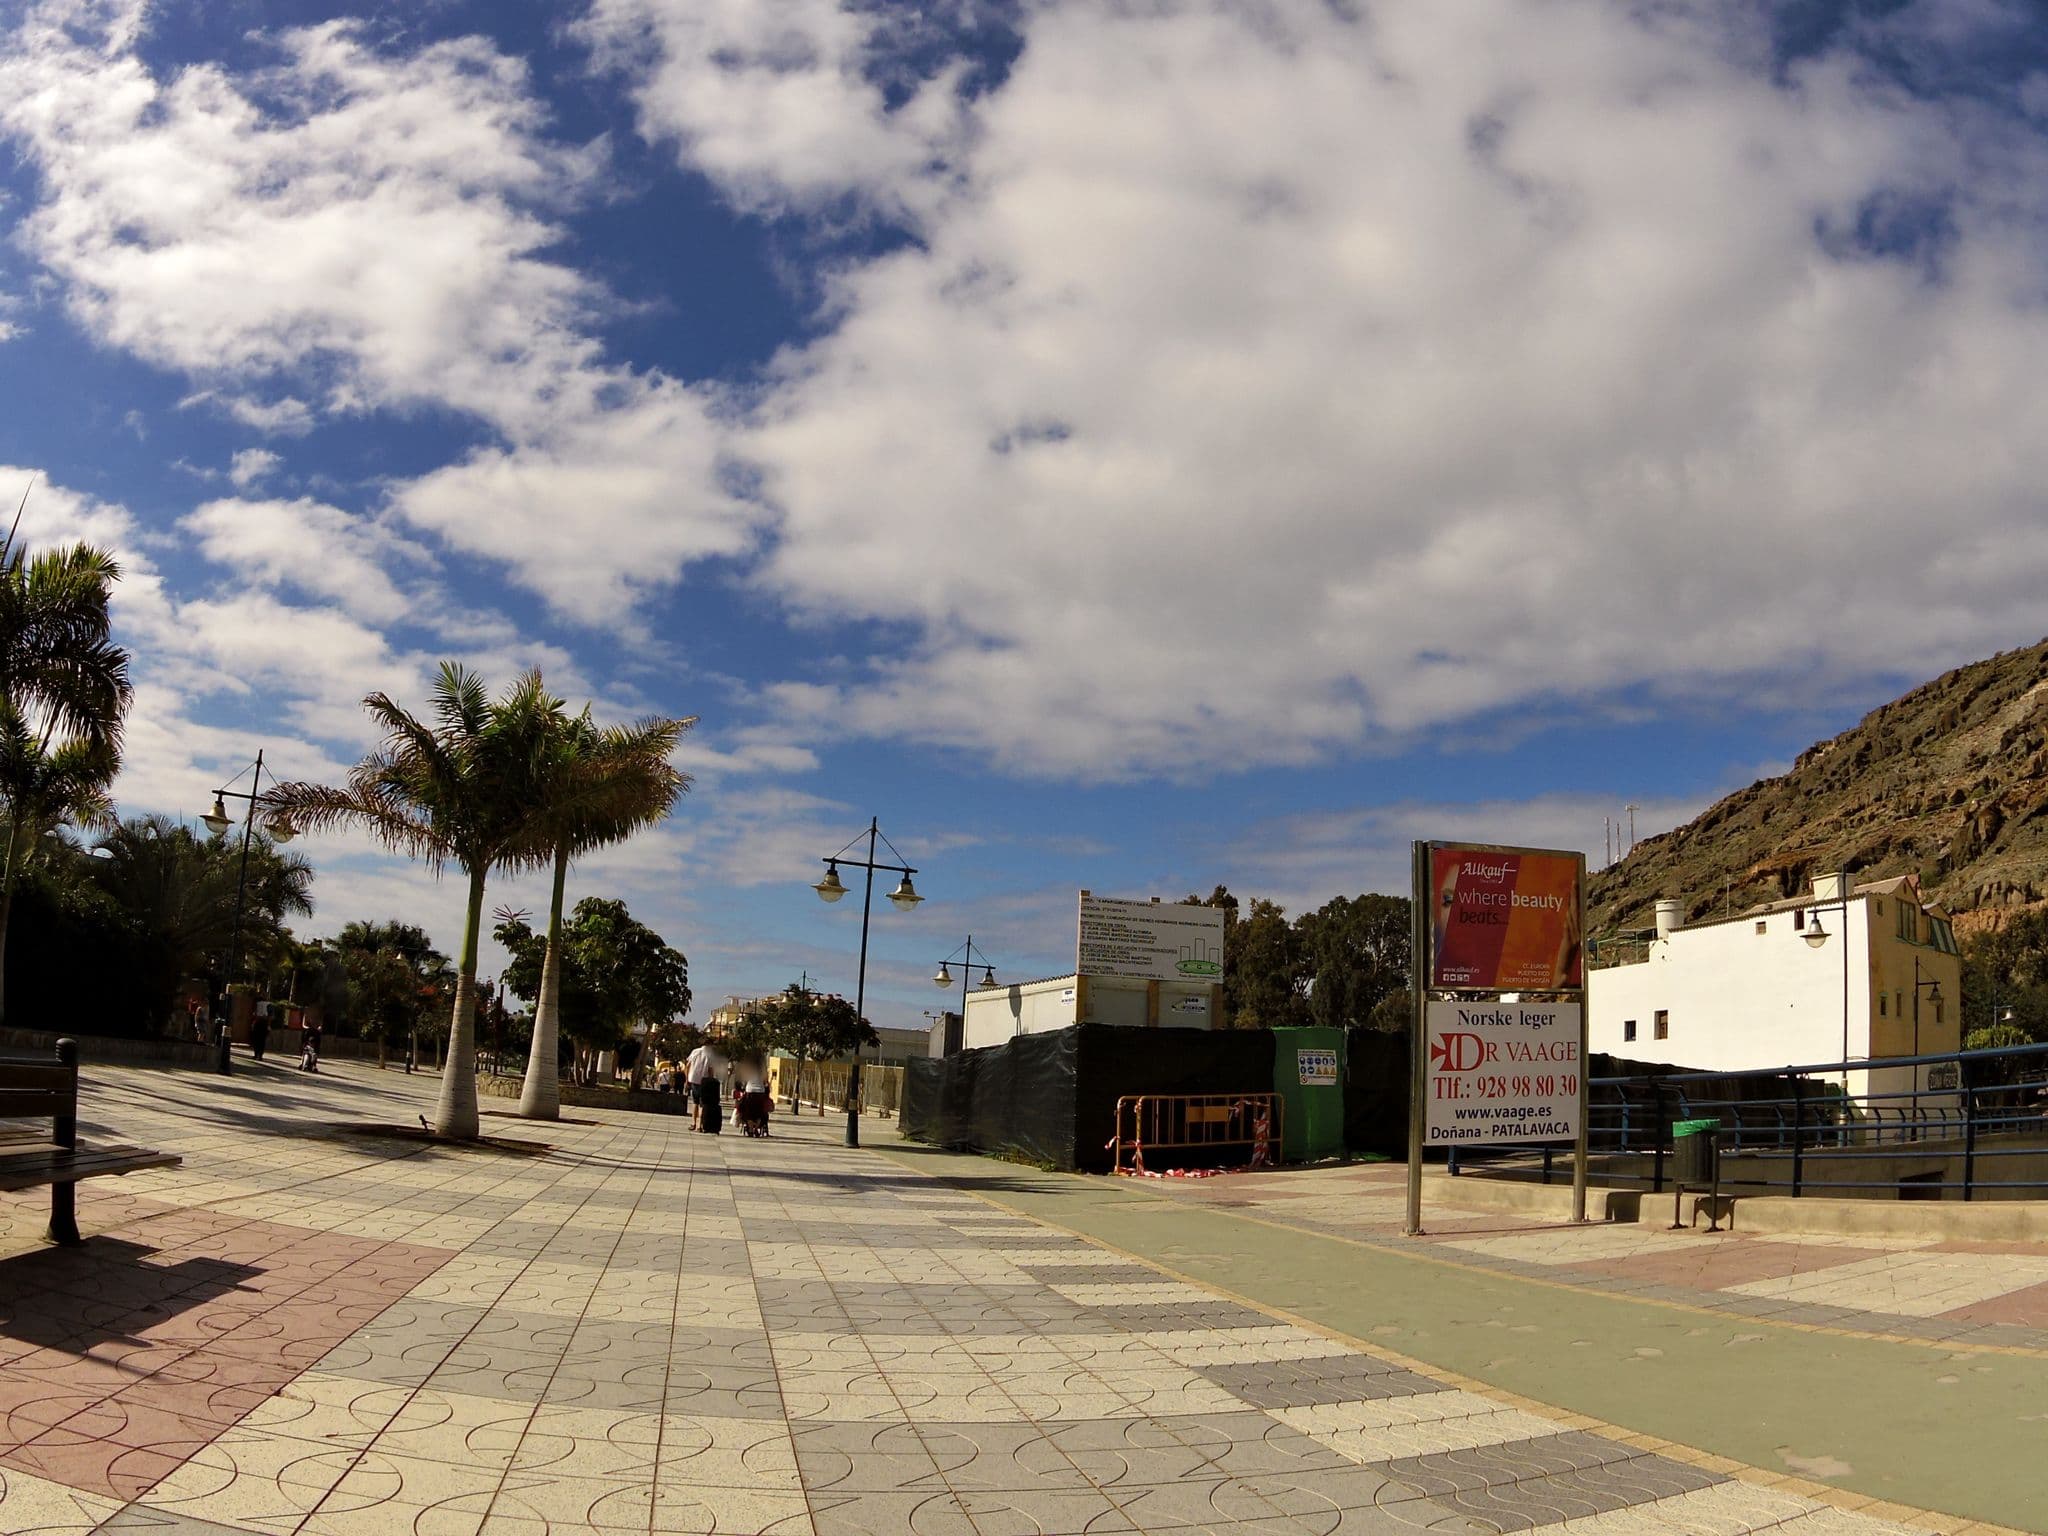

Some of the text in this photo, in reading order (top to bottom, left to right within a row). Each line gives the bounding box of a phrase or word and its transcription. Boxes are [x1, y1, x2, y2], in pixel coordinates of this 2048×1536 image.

[1461, 862, 1517, 884] Allkauf
[1458, 887, 1563, 912] where beauty
[1457, 1009, 1556, 1030] Norske leger
[1505, 1041, 1577, 1062] VAAGE
[1433, 1074, 1577, 1099] Tlf.: 928 98 80 30
[1455, 1106, 1552, 1121] www.vaage.es
[1431, 1126, 1481, 1139] Doñana
[1492, 1122, 1570, 1137] PATALAVACA
